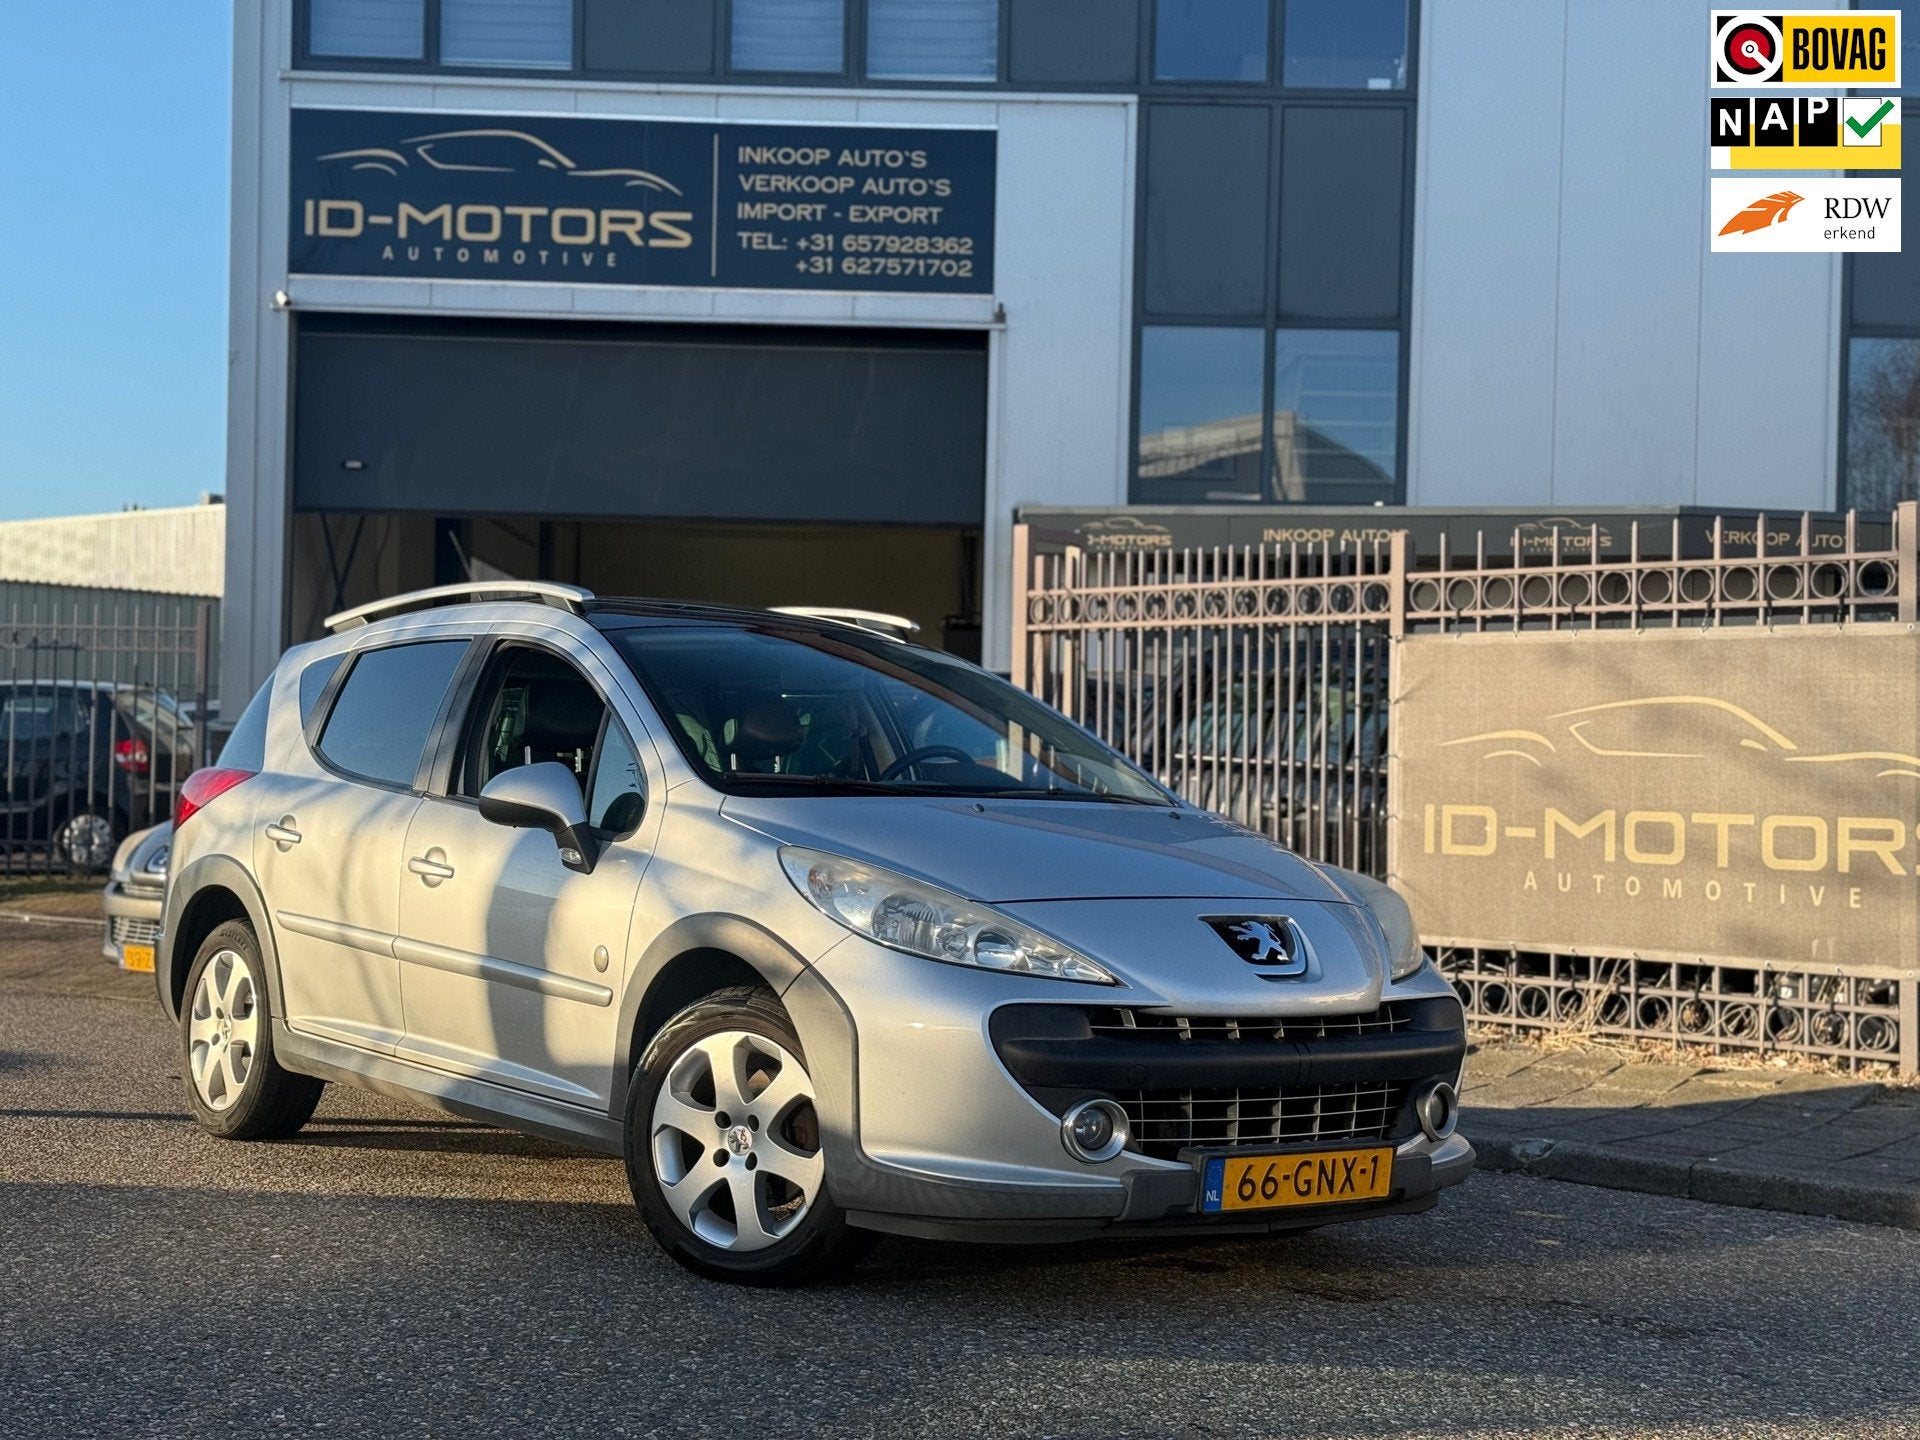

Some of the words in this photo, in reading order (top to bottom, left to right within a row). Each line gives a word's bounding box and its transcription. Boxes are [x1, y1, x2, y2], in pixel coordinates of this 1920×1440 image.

[738, 146, 830, 166] INKOOP
[738, 174, 855, 194] VERKOOP
[304, 199, 693, 249] ID-MOTORS
[737, 202, 827, 222] IMPORT
[848, 205, 943, 224] EXPORT
[737, 231, 788, 250] TEL:
[796, 234, 834, 251] +31
[842, 235, 974, 255] 657928362
[383, 245, 617, 267] AUTOMOTIVE
[796, 256, 833, 274] +31
[842, 257, 974, 277] 627571702
[1263, 528, 1334, 543] INKOOP
[1341, 528, 1409, 543] AUTO
[1424, 803, 1920, 876] ID-MOTOR
[1524, 870, 1862, 909] AUTOMOTIVE
[1237, 1154, 1379, 1202] 66-GNX-1
[1206, 1189, 1220, 1202] NL
